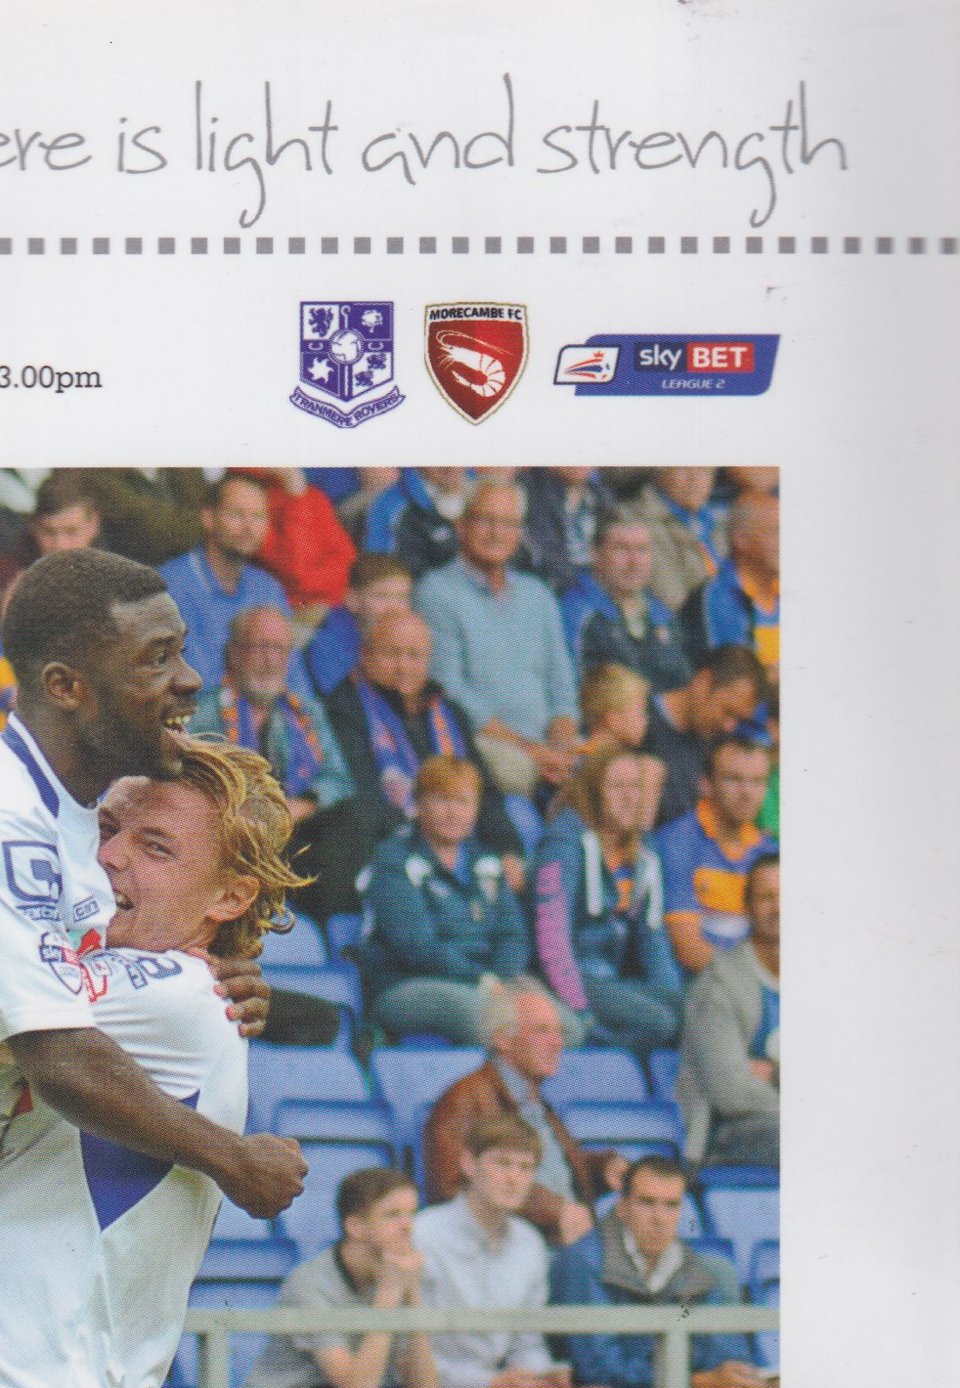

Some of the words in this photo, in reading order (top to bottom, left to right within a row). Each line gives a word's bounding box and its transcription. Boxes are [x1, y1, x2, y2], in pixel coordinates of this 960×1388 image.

[118, 116, 168, 175] is
[196, 81, 336, 228] light
[362, 73, 515, 185] and
[537, 81, 848, 228] strength
[428, 307, 504, 321] MORECAMBE
[507, 308, 523, 320] FC
[640, 344, 682, 371] sky
[692, 347, 747, 369] BET
[661, 379, 713, 389] LEAGUE
[715, 379, 726, 389] 2
[293, 393, 353, 428] TRANMERE
[354, 391, 401, 424] ROVERS
